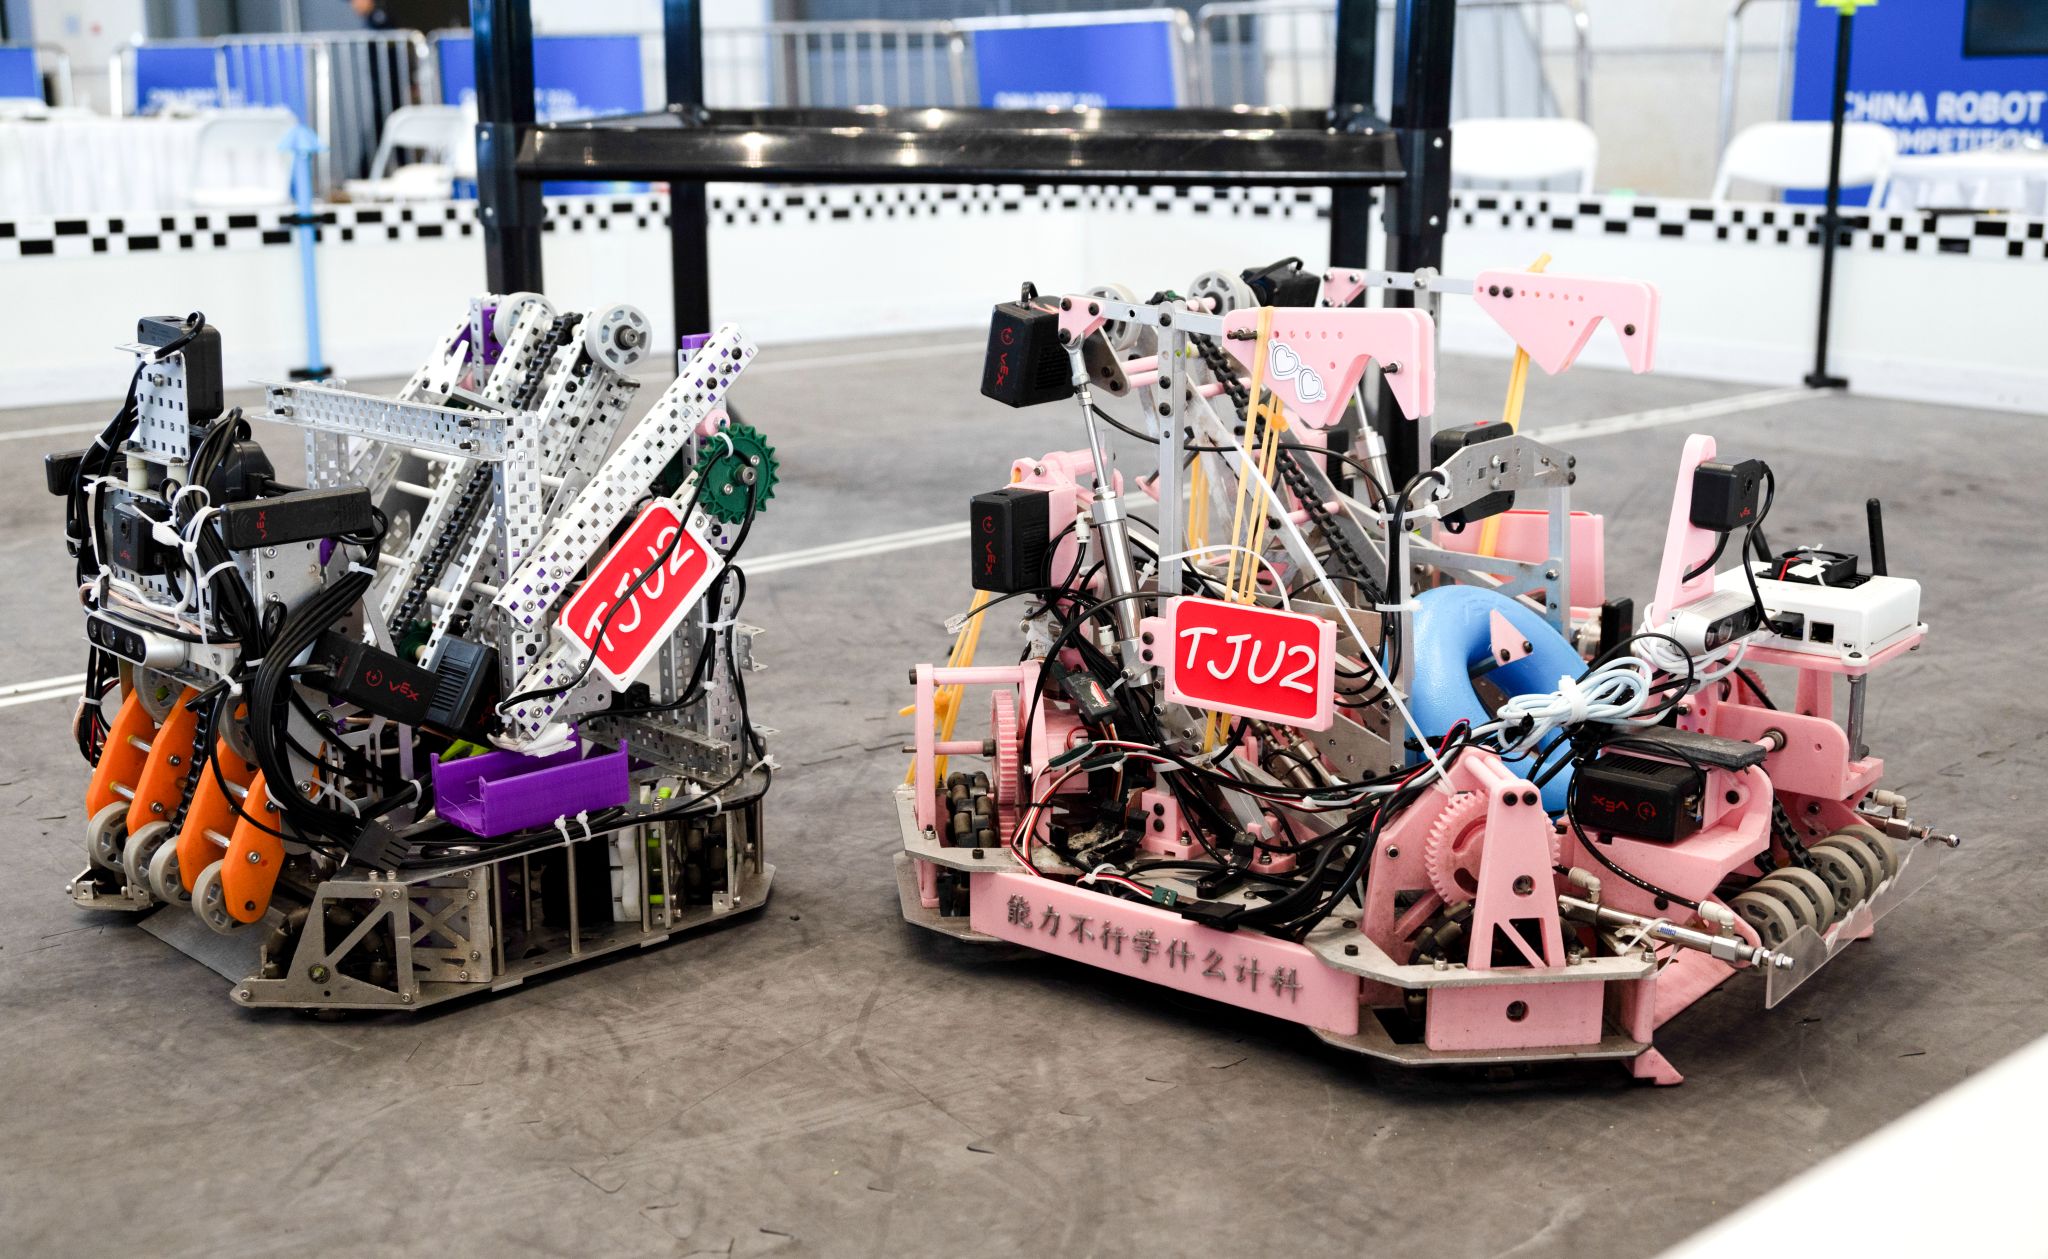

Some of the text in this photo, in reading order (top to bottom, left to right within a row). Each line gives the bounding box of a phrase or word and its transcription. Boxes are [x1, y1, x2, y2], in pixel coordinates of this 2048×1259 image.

[1936, 90, 2047, 125] ROBOT
[996, 352, 1009, 385] VEX
[256, 511, 267, 540] VEX
[985, 541, 996, 576] VEX
[584, 526, 695, 652] TJU2
[1179, 626, 1317, 694] TJU2
[389, 680, 420, 701] VEX
[1592, 794, 1629, 813] VEX
[1006, 893, 1304, 1005] 能力不行学什么计科
